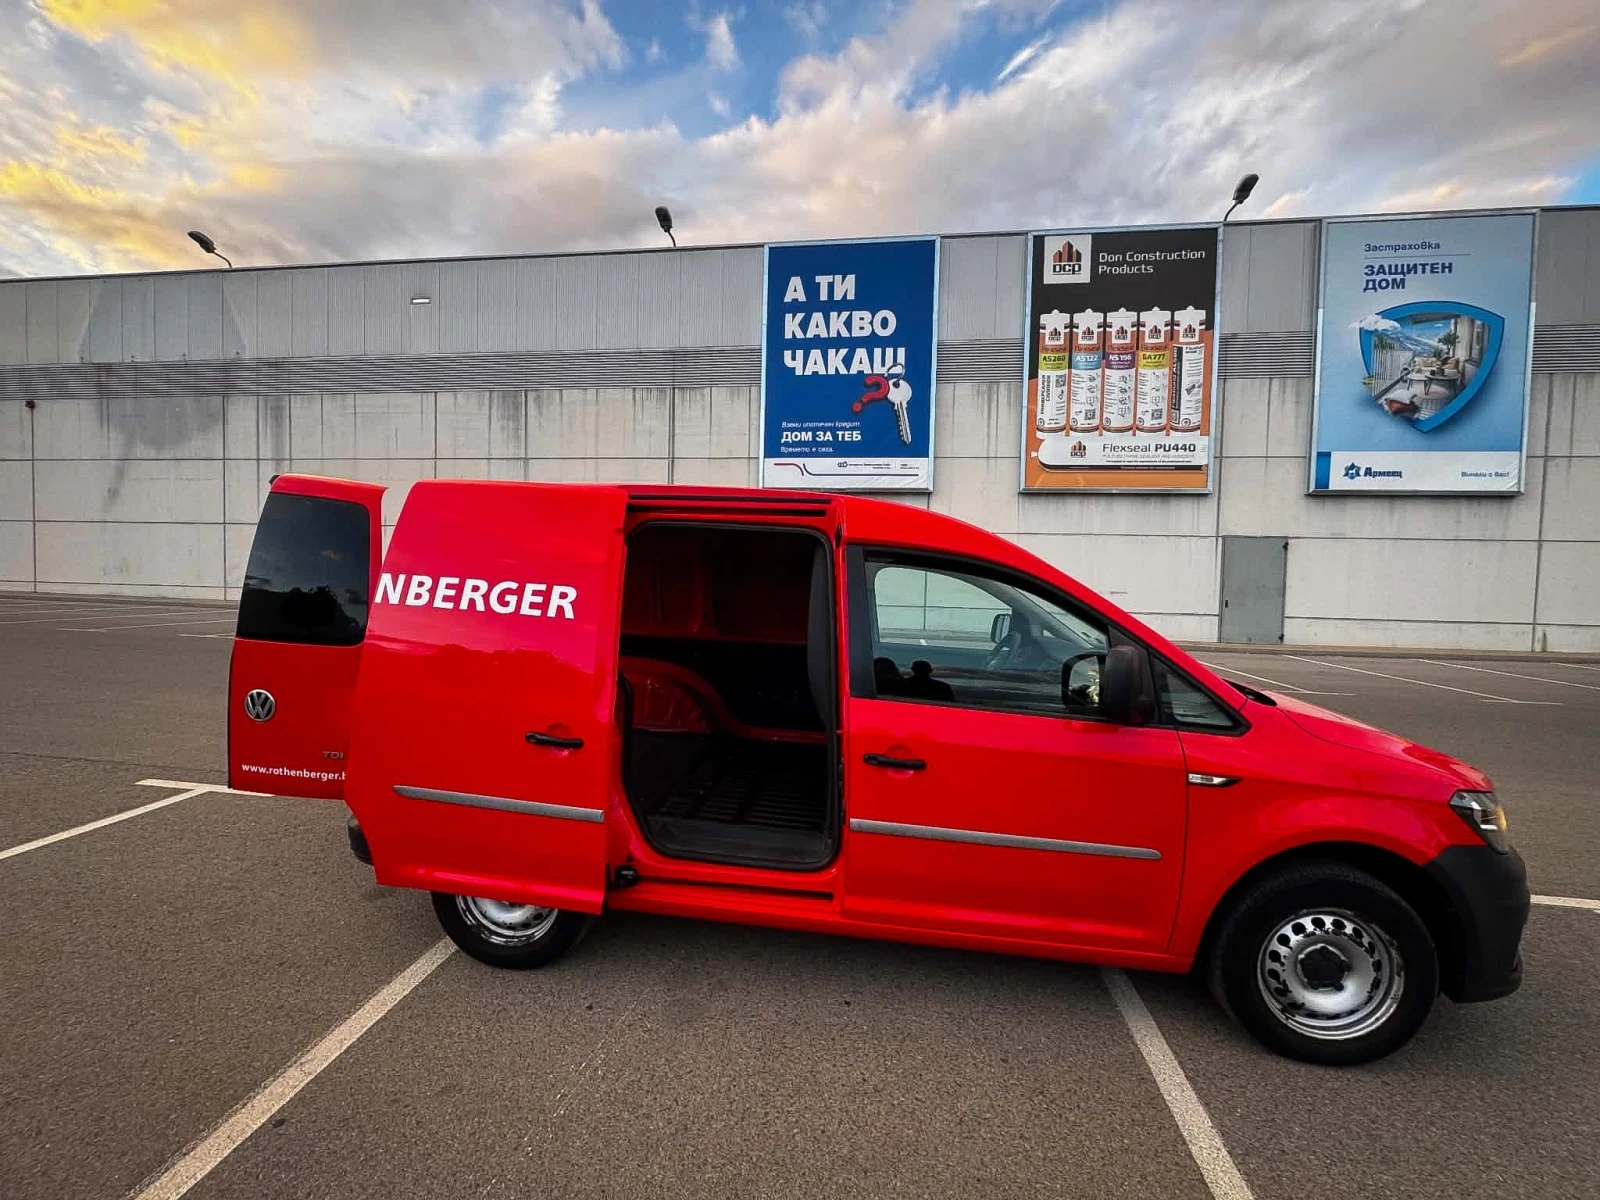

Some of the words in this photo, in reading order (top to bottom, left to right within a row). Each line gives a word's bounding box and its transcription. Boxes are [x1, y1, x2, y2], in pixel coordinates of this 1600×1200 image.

[1364, 240, 1440, 255] Застраховка
[1099, 252, 1122, 263] Don
[1126, 249, 1206, 262] Construction
[1098, 263, 1154, 275] Products
[1363, 262, 1453, 277] ЗАЩИТЕН
[815, 274, 856, 301] ТИ
[1363, 278, 1406, 292] ДОМ
[784, 309, 897, 339] КАКВО
[783, 347, 906, 376] ЧАКАШ
[780, 431, 813, 444] ДОМ
[815, 431, 833, 442] ЗА
[1102, 443, 1151, 453] Flexseal
[1154, 443, 1197, 453] PU440
[374, 572, 578, 620] NBERGER
